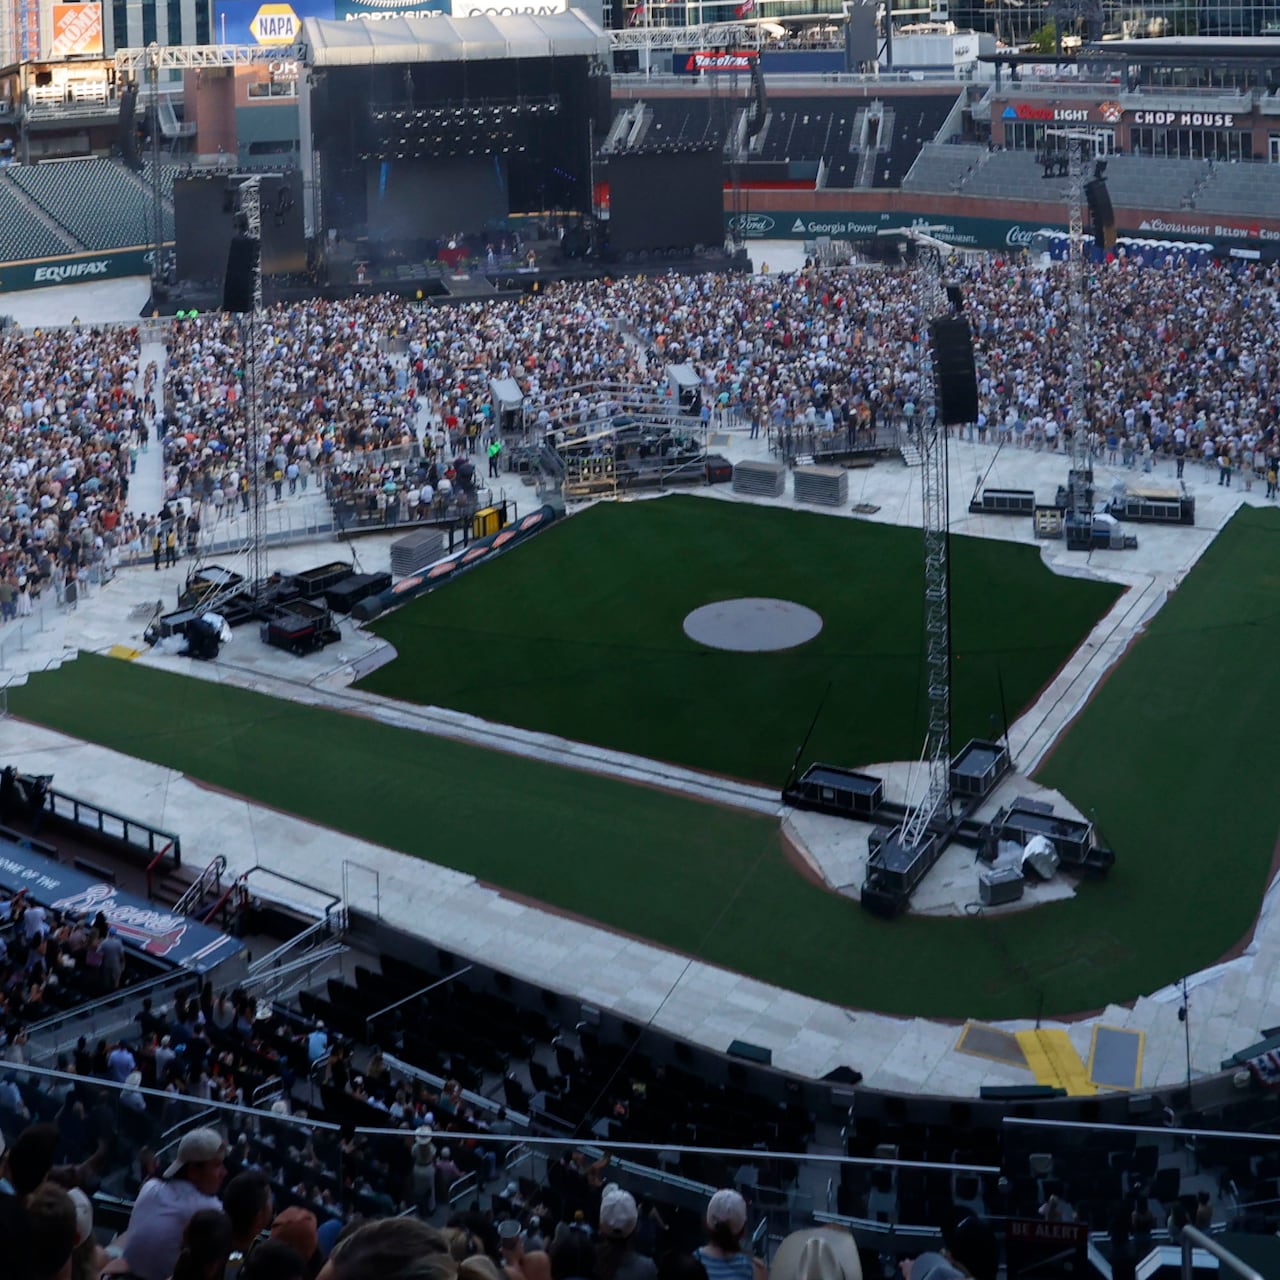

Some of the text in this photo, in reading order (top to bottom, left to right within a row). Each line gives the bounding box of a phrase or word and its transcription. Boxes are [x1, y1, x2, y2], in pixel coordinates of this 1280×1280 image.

[260, 17, 294, 36] NAPA
[1054, 109, 1089, 121] LIGHT
[1134, 111, 1234, 127] CHOP HOUSE
[808, 221, 878, 236] Georgia Power
[1181, 224, 1210, 235] LIGHT
[1215, 226, 1248, 237] BELOW
[33, 260, 110, 283] EQUIFAX
[36, 874, 62, 891] THE
[1034, 1223, 1080, 1240] ALERT
